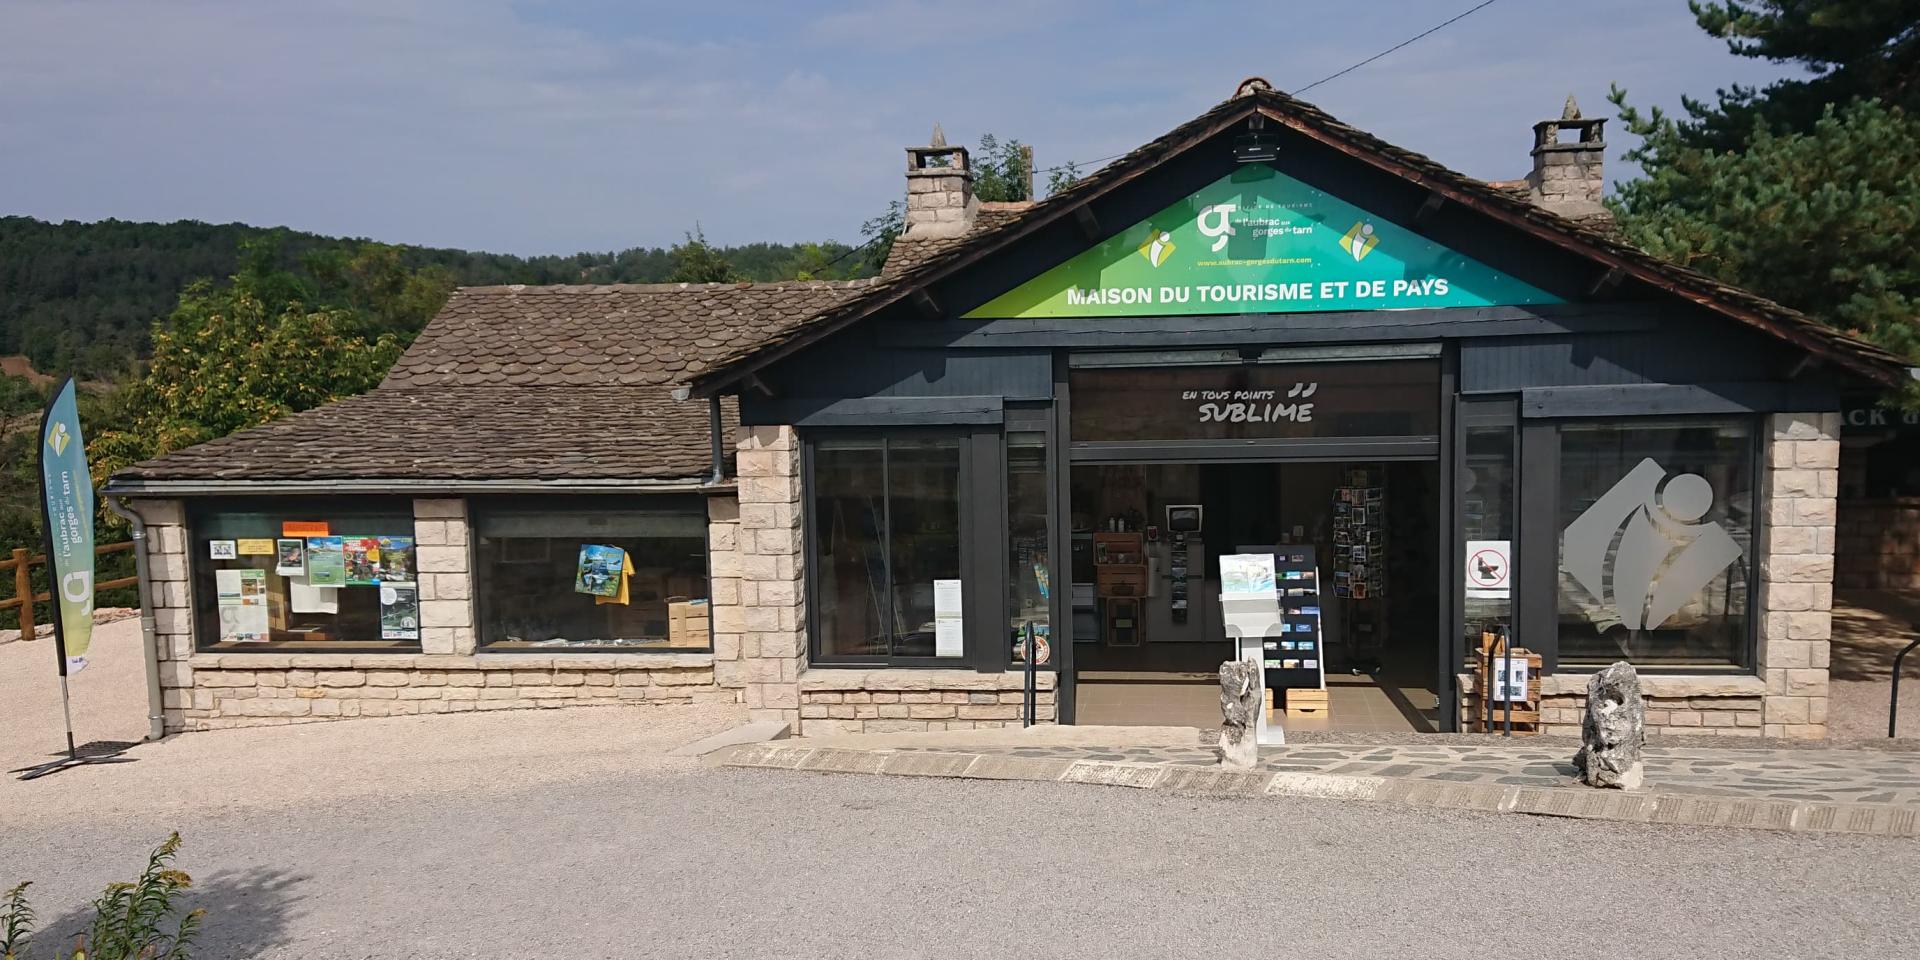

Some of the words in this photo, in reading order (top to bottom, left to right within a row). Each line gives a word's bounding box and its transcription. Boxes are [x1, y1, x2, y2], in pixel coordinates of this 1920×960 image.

[1243, 217, 1280, 227] l'aubrac
[1252, 227, 1284, 238] gorges
[1292, 226, 1313, 235] tarn
[1067, 287, 1152, 305] MAISON
[1159, 286, 1190, 304] DU
[1196, 282, 1313, 303] TOURISME
[1320, 281, 1349, 299] ET
[1355, 280, 1386, 298] DE
[1393, 278, 1449, 297] PAYS
[1182, 390, 1198, 400] EN
[1201, 390, 1231, 400] TOUS
[1234, 390, 1275, 400] POINTS
[1198, 402, 1315, 423] SUBLIME
[61, 471, 71, 495] tarn
[59, 512, 72, 557] l'aubrac
[66, 506, 83, 544] gorges
